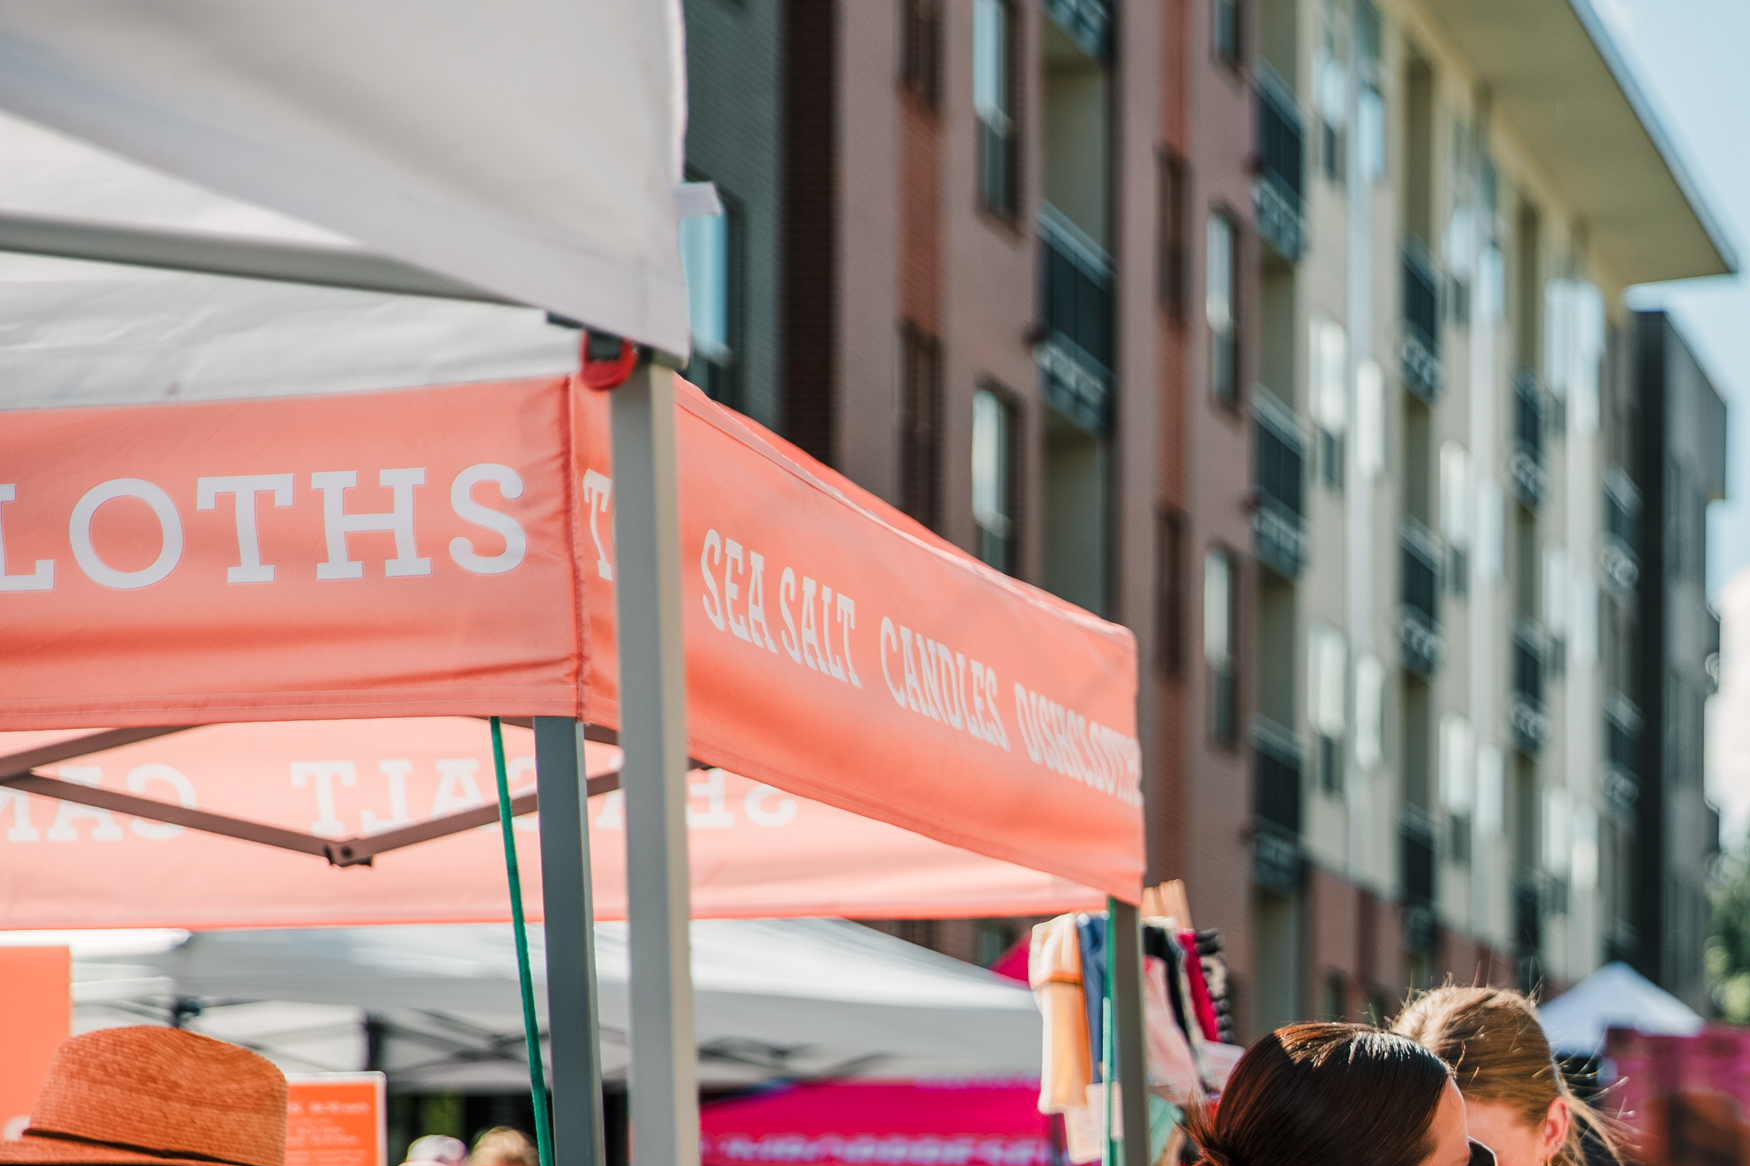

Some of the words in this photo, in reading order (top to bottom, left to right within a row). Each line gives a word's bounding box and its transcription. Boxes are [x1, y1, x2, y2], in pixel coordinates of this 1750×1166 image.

[700, 529, 778, 656] SEA
[779, 565, 863, 690] SALT
[880, 616, 1010, 752] CANDLES
